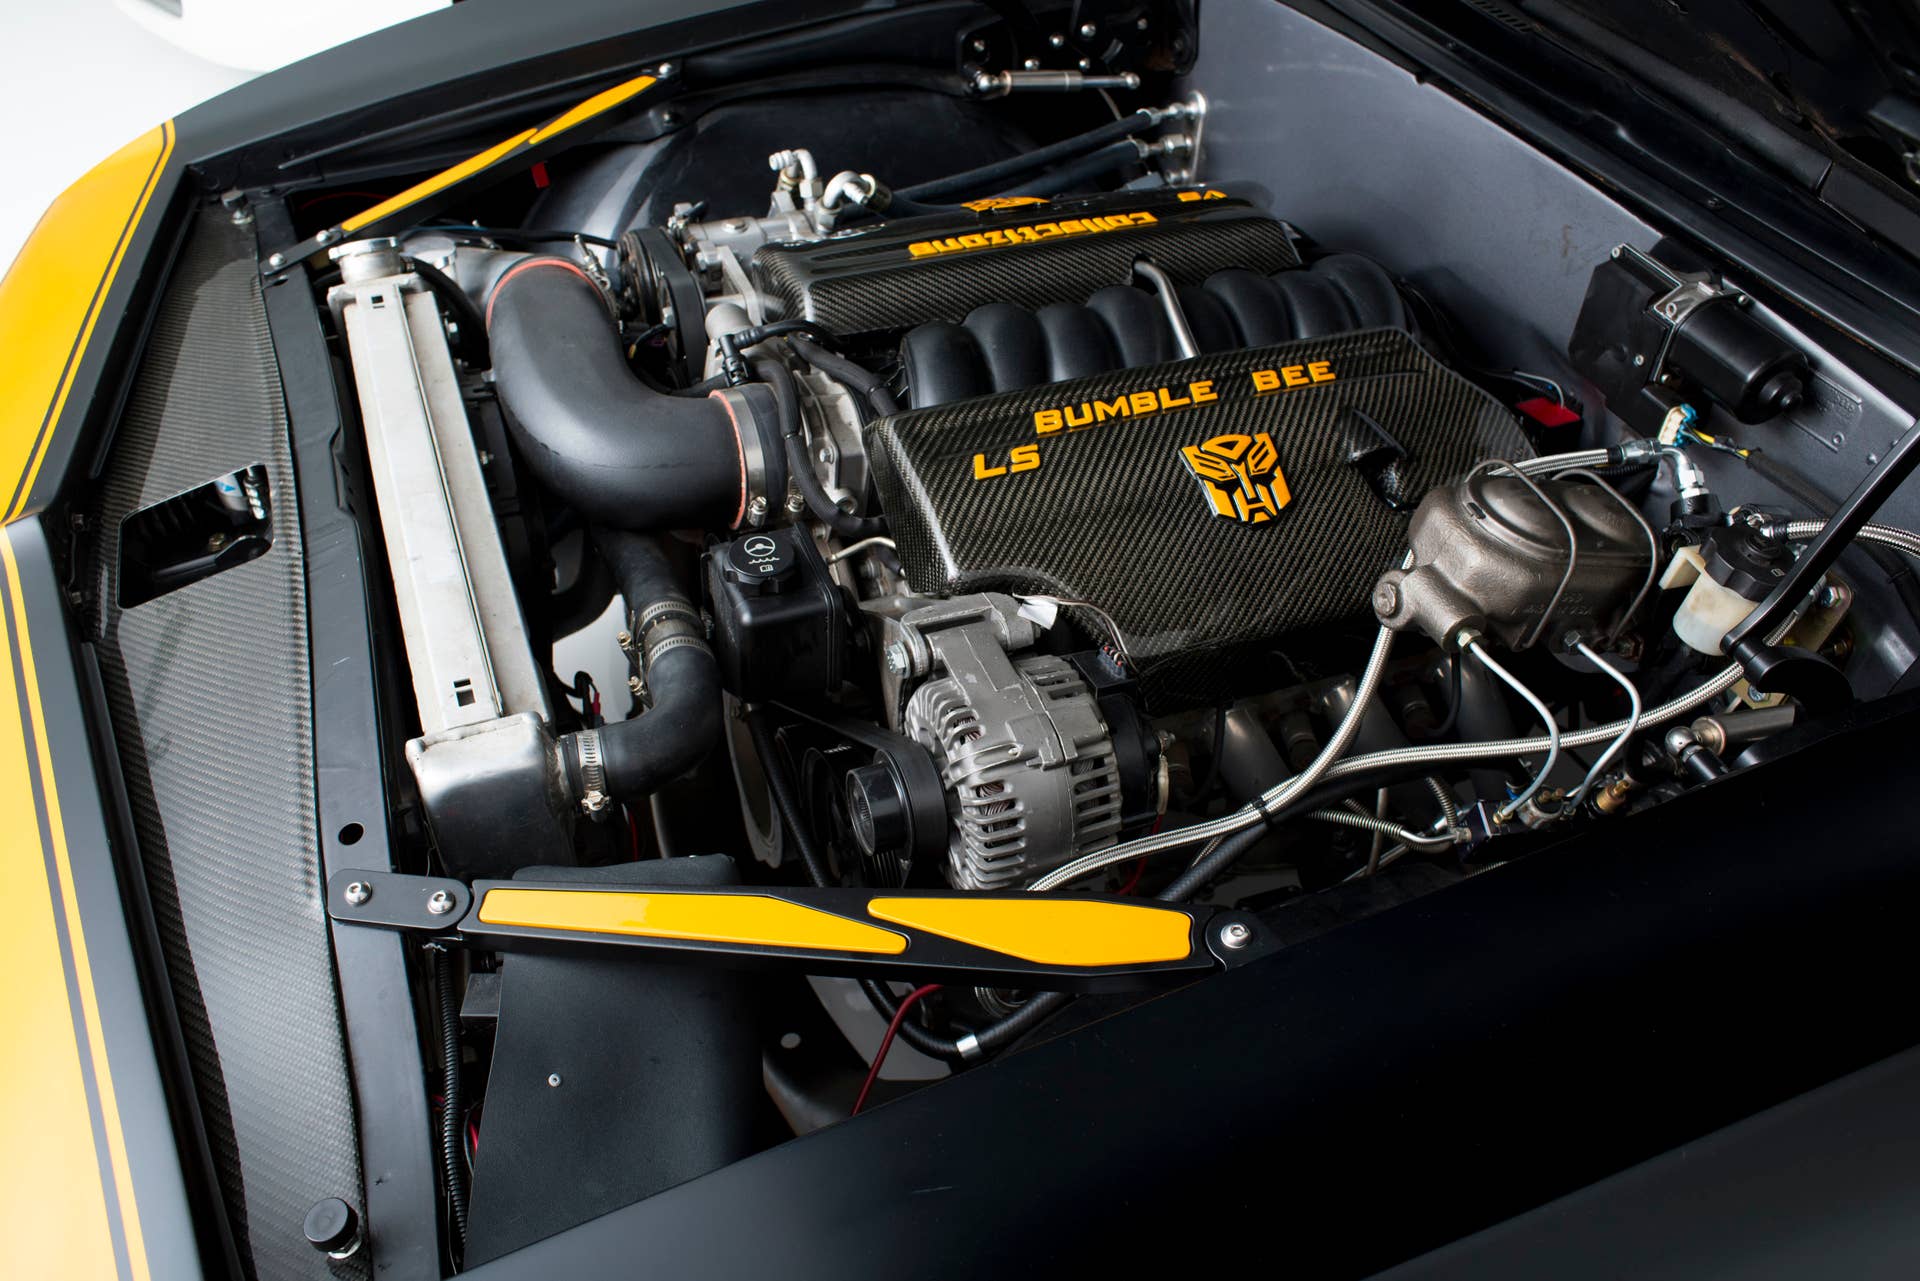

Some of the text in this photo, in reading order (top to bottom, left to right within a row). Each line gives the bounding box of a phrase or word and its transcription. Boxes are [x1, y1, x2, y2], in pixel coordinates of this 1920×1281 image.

[1034, 360, 1336, 435] BUMBLE BEE
[974, 444, 1041, 480] LS
